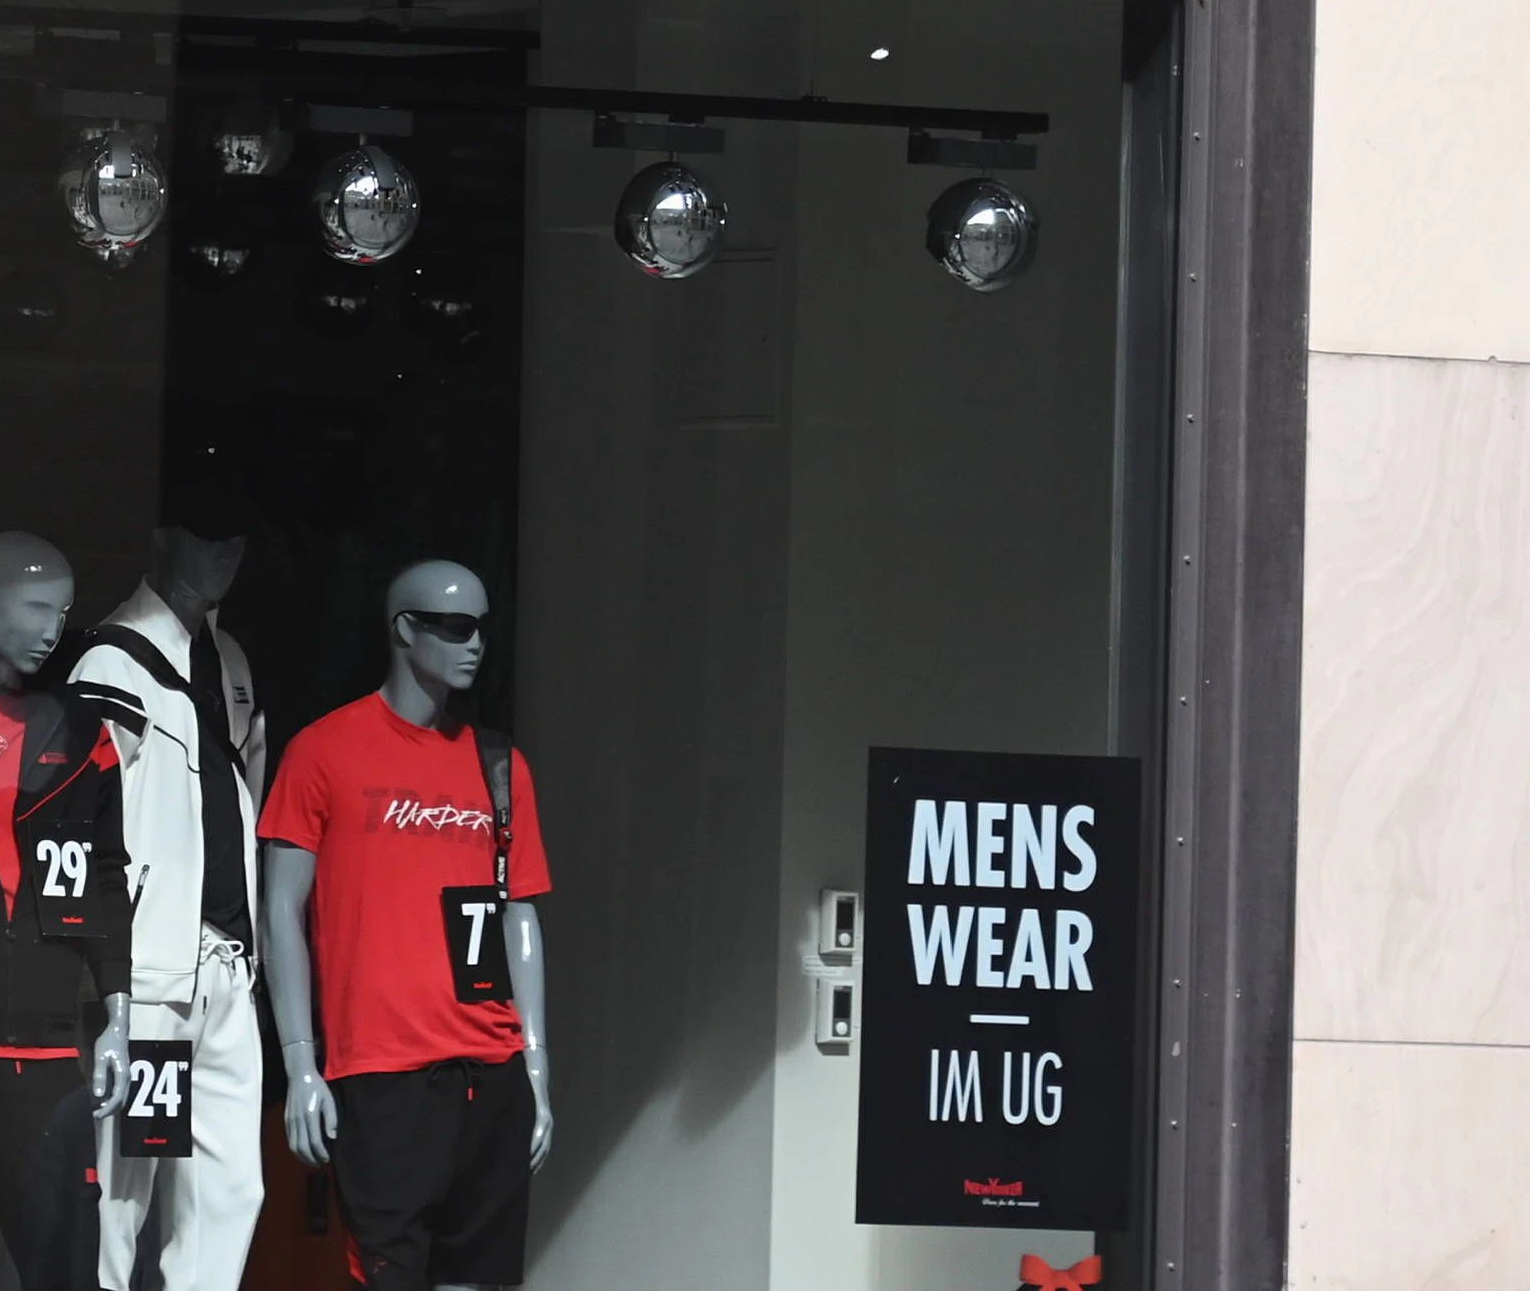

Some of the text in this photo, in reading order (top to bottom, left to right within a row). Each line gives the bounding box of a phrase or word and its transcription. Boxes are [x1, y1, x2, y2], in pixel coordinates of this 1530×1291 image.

[383, 800, 493, 836] HARDER
[907, 799, 1097, 892] MENS
[906, 904, 1094, 991] WEAR
[929, 1048, 1063, 1126] IM UG
